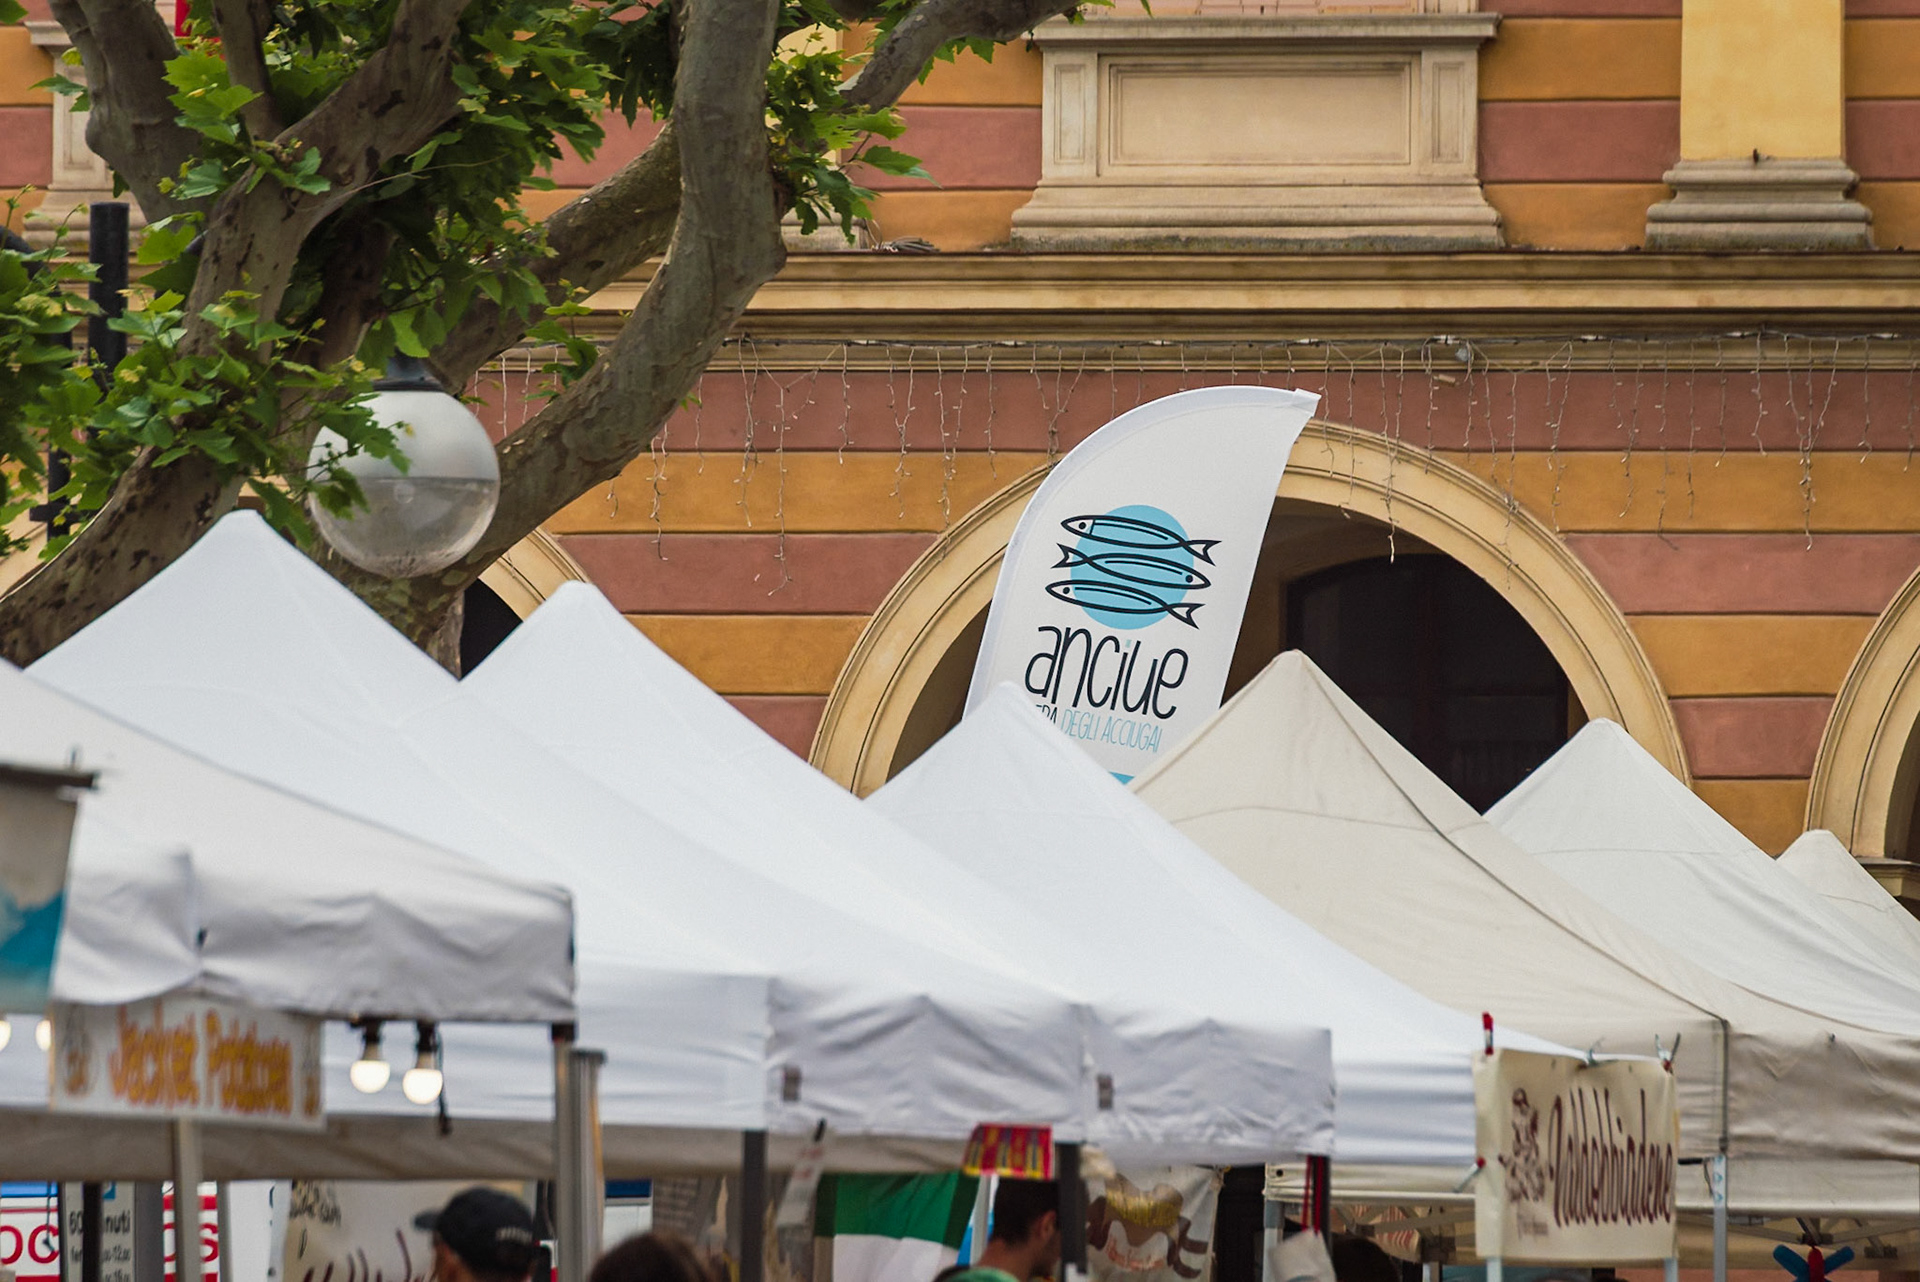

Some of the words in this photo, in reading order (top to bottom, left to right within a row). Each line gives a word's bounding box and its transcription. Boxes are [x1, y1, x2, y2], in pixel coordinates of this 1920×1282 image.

[1025, 625, 1189, 720] anciue
[1060, 708, 1100, 741] DEGLI
[1101, 715, 1163, 753] ACCIUGAI
